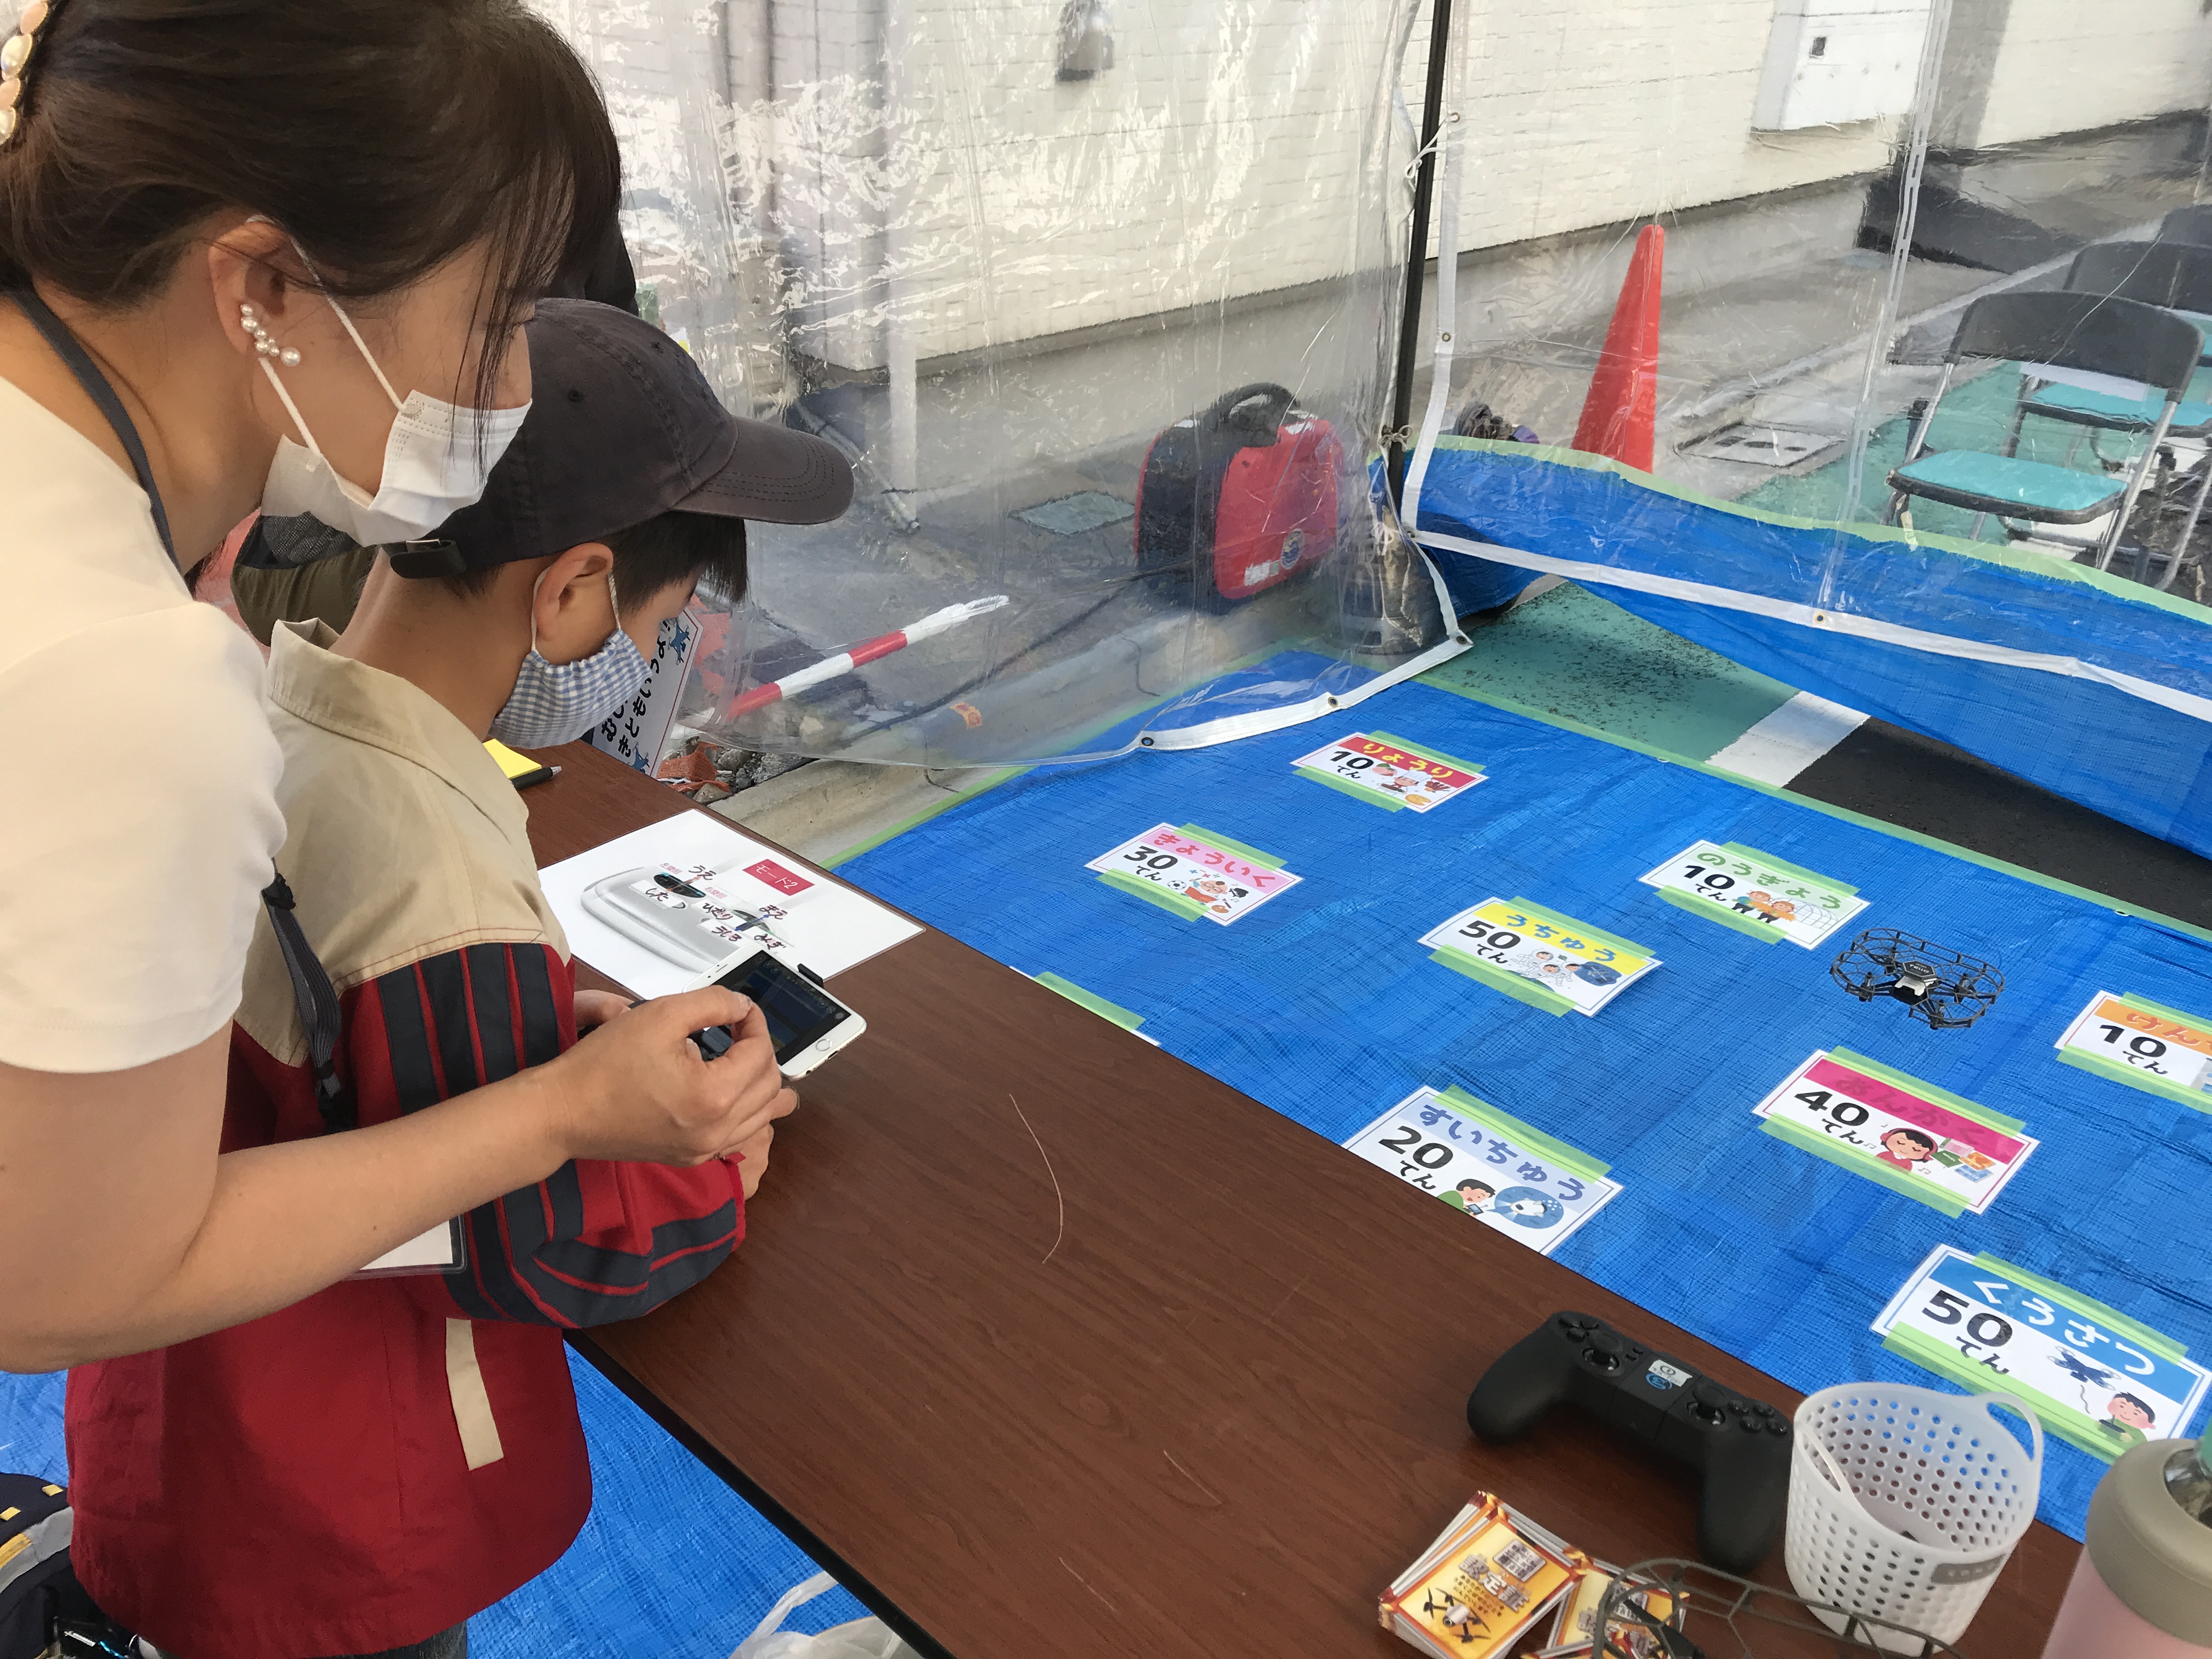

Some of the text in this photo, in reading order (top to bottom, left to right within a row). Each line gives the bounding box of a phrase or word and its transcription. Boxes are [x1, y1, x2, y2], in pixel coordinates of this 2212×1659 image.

[1330, 751, 1375, 769] 10
[1338, 766, 1362, 780] てん
[1363, 743, 1454, 778] りょうり
[1123, 845, 1178, 870] 30
[1153, 833, 1276, 888] きょういく
[688, 865, 716, 881] うえ
[756, 864, 798, 889] モード2
[1136, 865, 1163, 882] てん
[1683, 865, 1736, 890] 10
[1697, 852, 1842, 910] のうぎょう
[645, 887, 669, 902] した
[1695, 883, 1727, 902] てん
[702, 902, 733, 920] ひだり
[759, 904, 788, 920] まえ
[711, 926, 742, 942] うしろ
[754, 933, 787, 950] みぎ
[1458, 919, 1521, 950] 50
[1506, 913, 1618, 962] うちゅう
[1476, 943, 1508, 964] てん
[2099, 1024, 2167, 1058] 10
[2126, 1013, 2212, 1052] けん
[2122, 1050, 2168, 1075] てん
[1793, 1090, 1870, 1127] 40
[1836, 1075, 1985, 1146] おんがく
[1821, 1118, 1864, 1145] てん
[1378, 1125, 1454, 1170] 20
[1419, 1104, 1587, 1201] すいちゅう
[1399, 1160, 1437, 1190] てん
[1921, 1290, 2013, 1348] 50
[1973, 1280, 2155, 1376] くうさつ
[1955, 1335, 2010, 1375] てん
